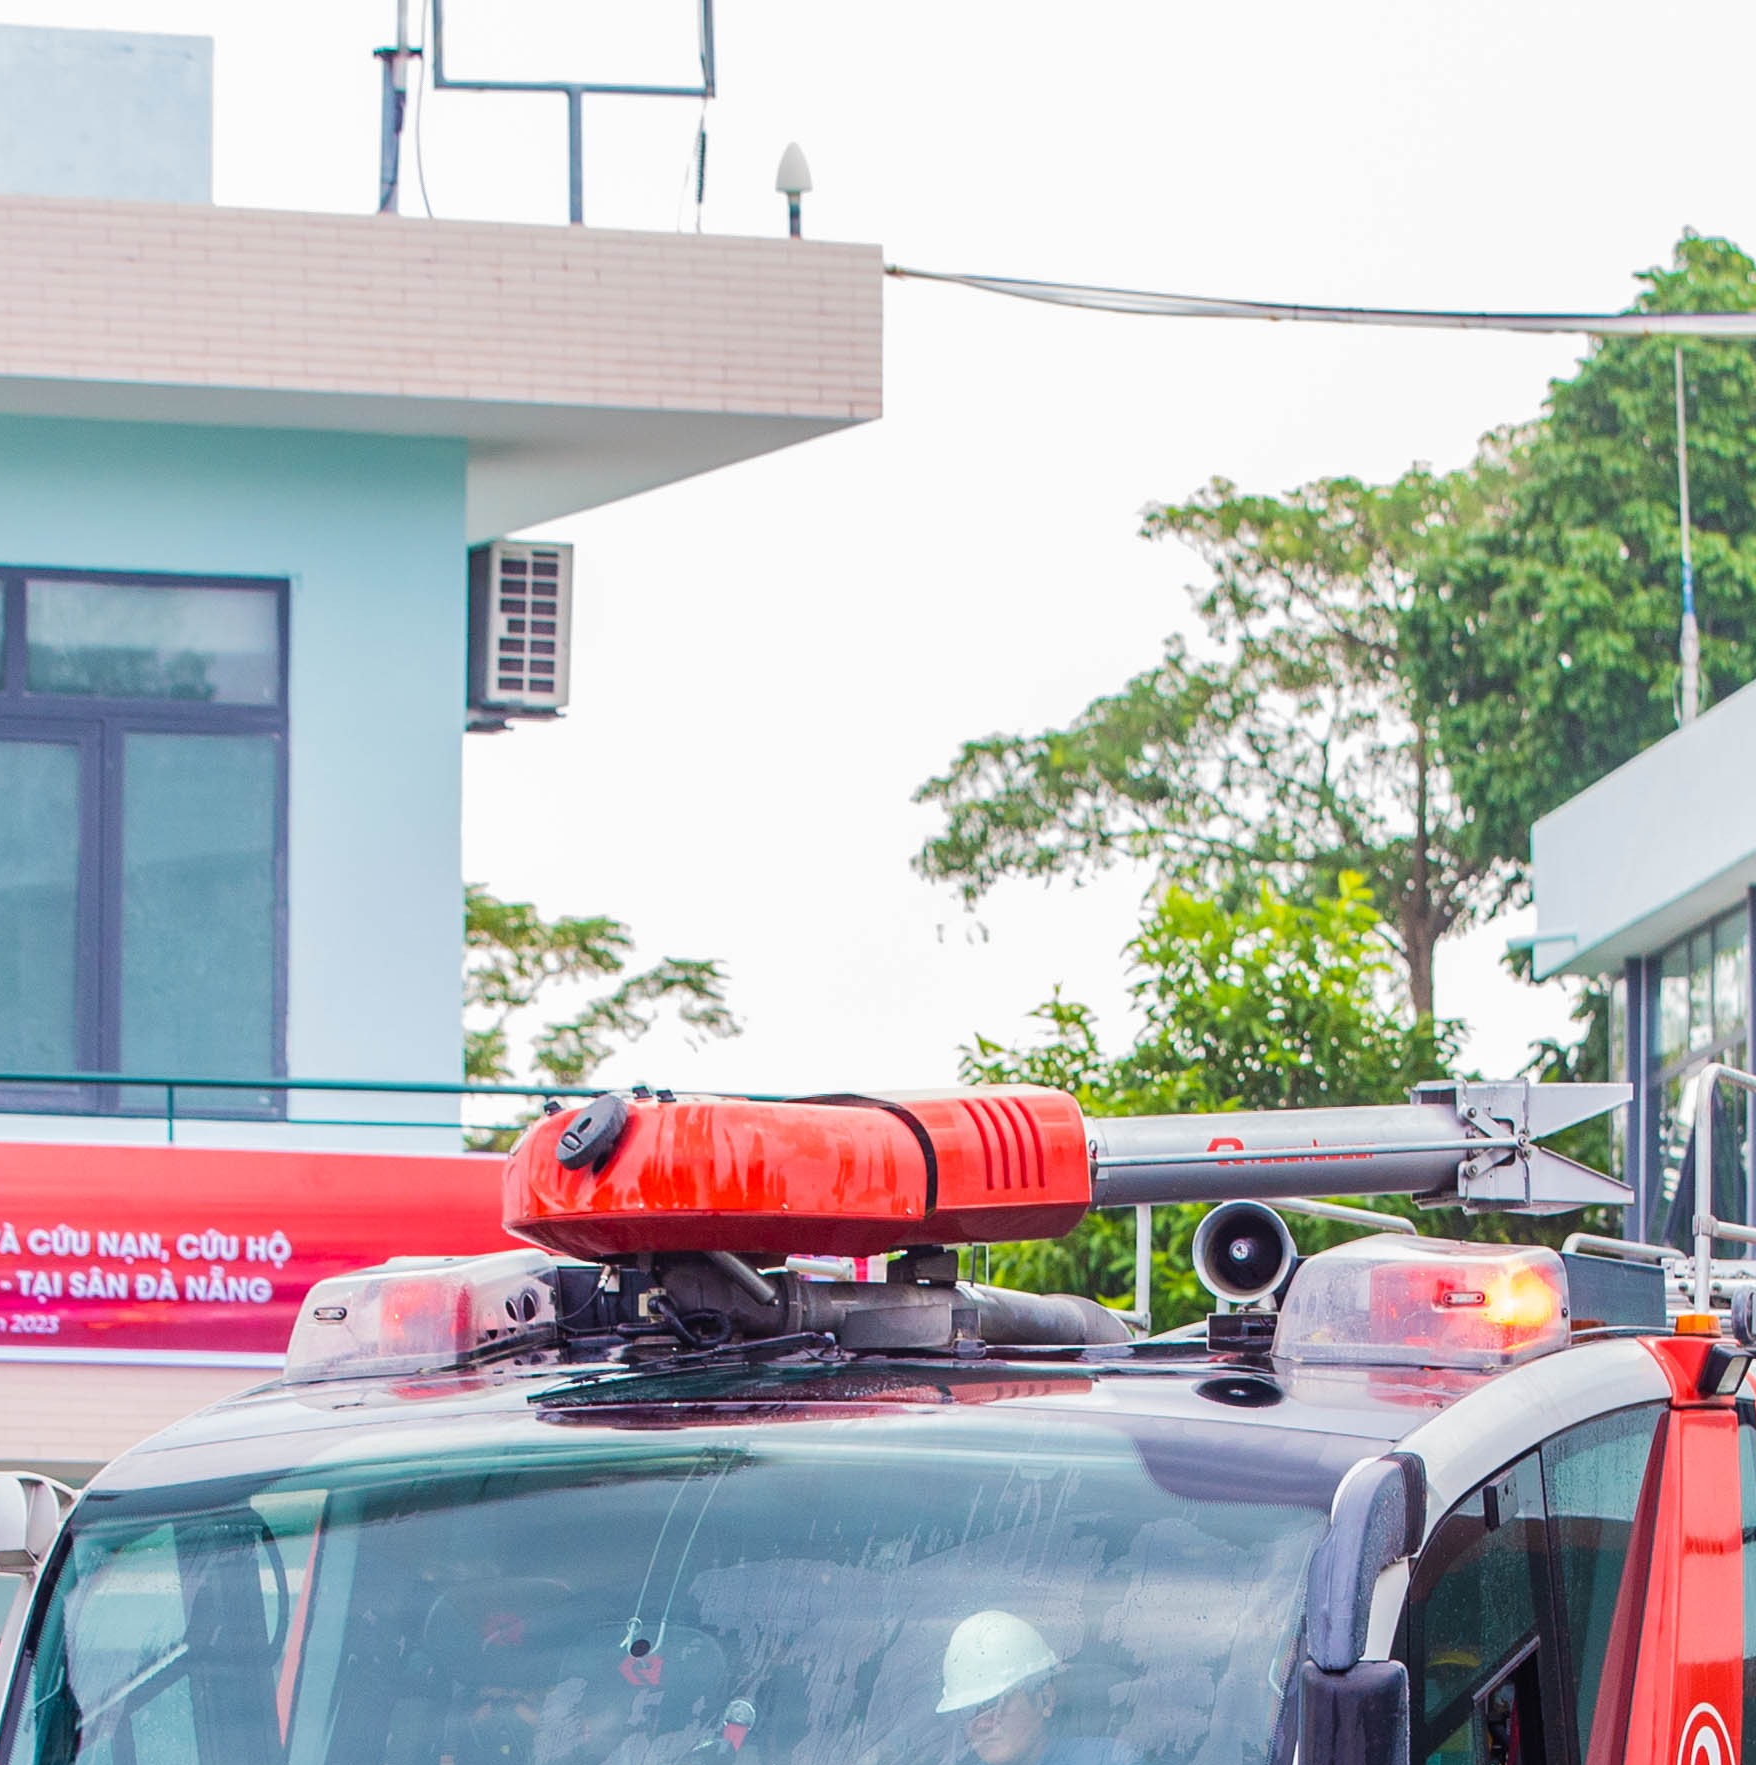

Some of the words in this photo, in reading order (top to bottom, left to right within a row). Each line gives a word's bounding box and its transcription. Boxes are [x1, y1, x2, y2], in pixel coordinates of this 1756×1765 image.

[27, 1223, 90, 1256] CỨU
[97, 1231, 170, 1265] NẠN,
[176, 1228, 240, 1261] CỨU
[245, 1230, 293, 1269] HỘ
[14, 1270, 63, 1304] TẠI
[68, 1266, 129, 1300] SÂN
[133, 1267, 179, 1301] ĐÀ
[184, 1264, 273, 1304] NẴNG
[9, 1313, 60, 1335] 2023
